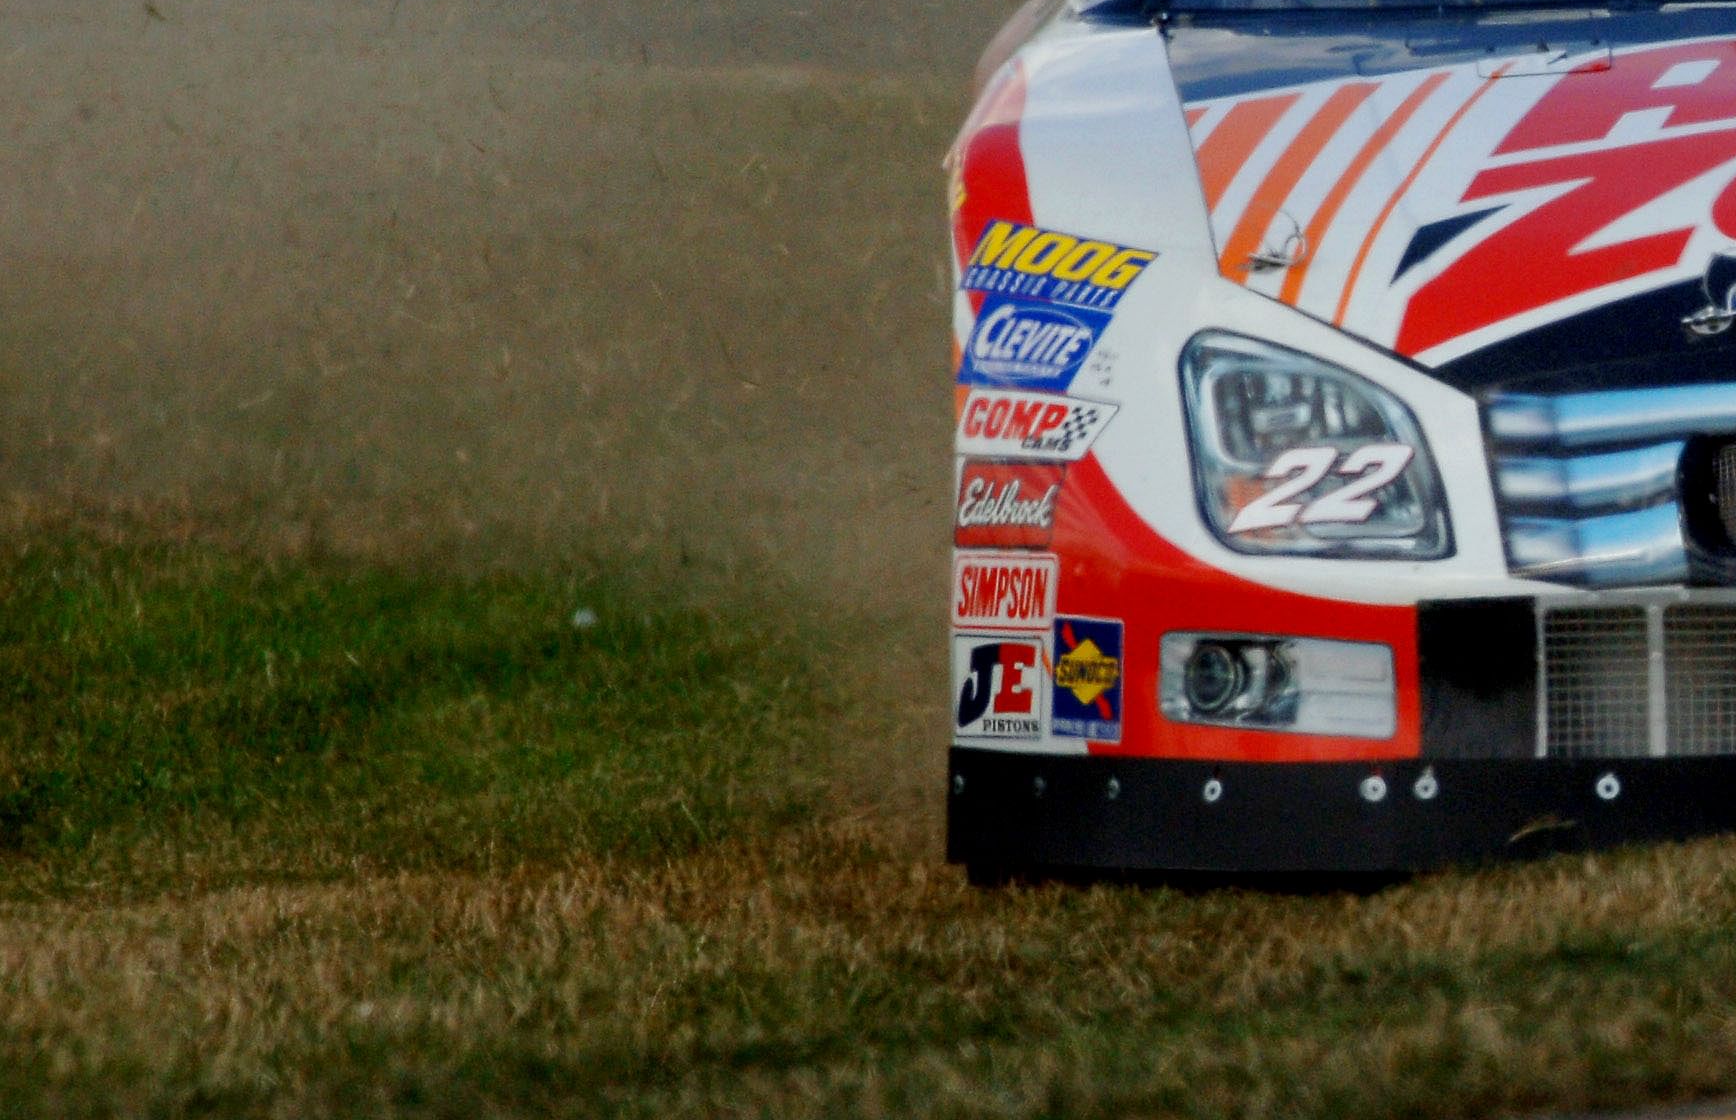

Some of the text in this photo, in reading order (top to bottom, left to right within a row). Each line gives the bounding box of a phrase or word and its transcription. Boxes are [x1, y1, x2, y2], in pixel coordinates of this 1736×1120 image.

[969, 220, 1155, 289] MOOG
[963, 397, 1069, 439] COMP
[1021, 435, 1073, 451] CAMS
[959, 478, 1060, 527] Edelbrock
[1227, 444, 1416, 534] 22
[957, 565, 1048, 619] SIMPSON
[957, 642, 1036, 728] JE
[982, 719, 1040, 732] PISTONS
